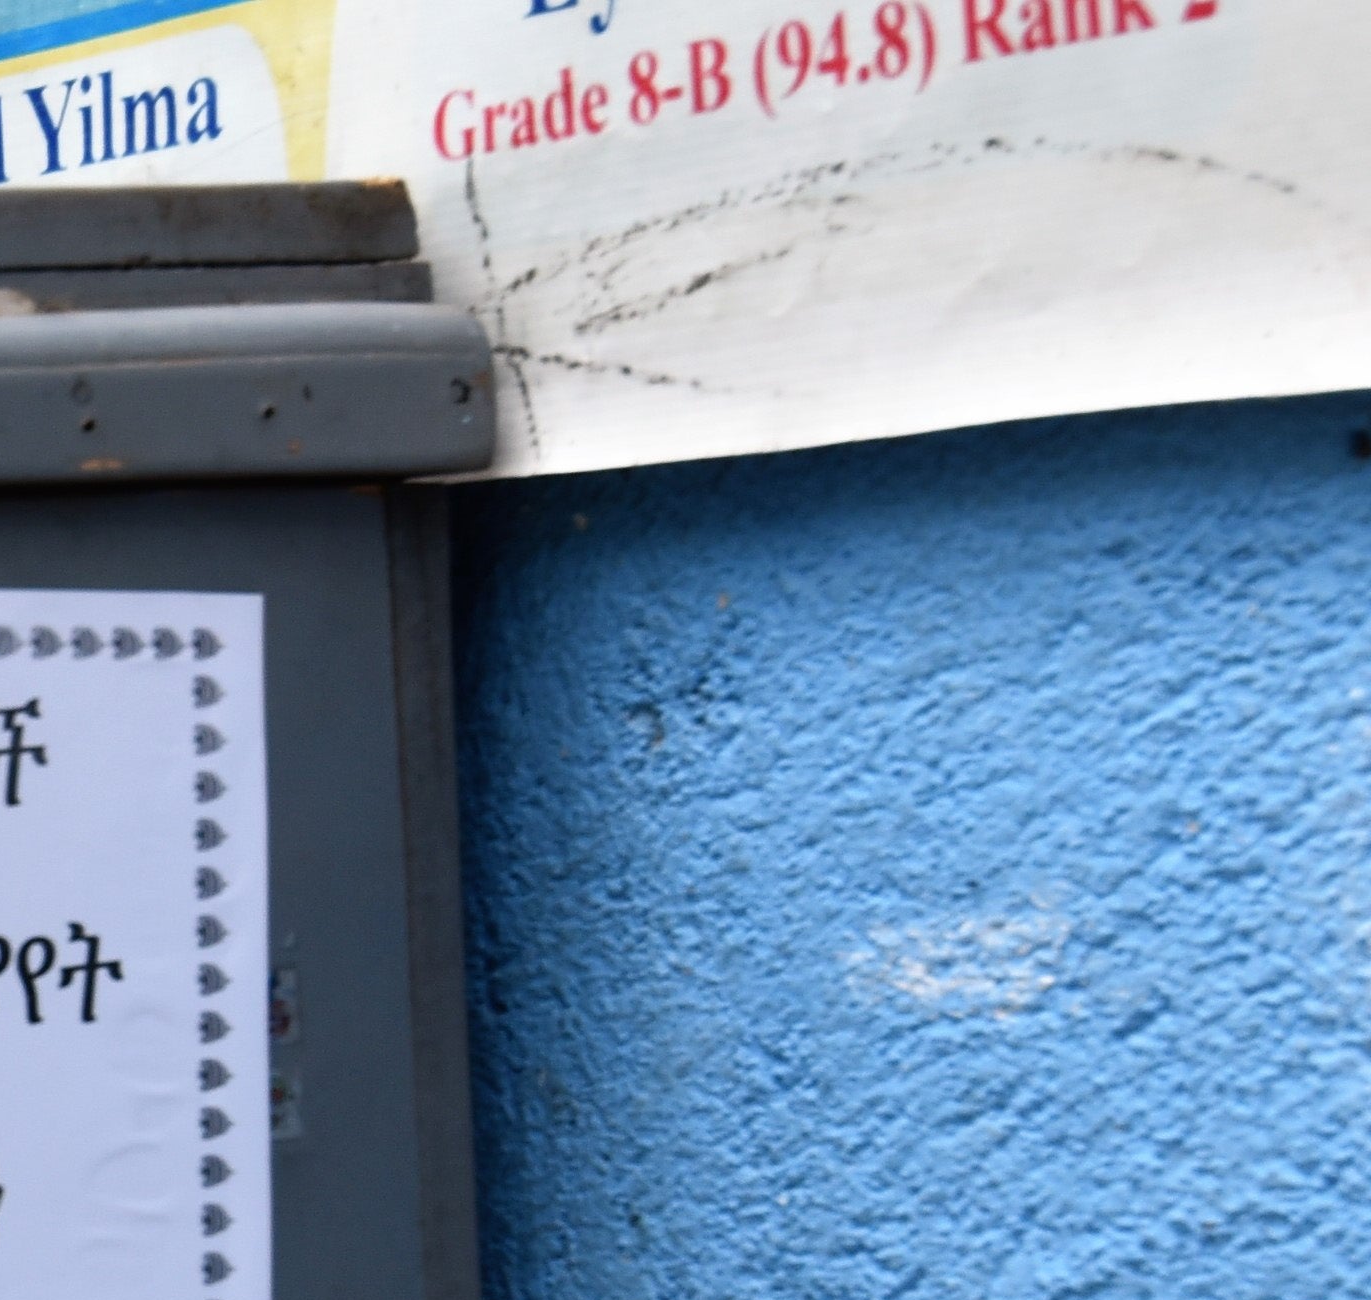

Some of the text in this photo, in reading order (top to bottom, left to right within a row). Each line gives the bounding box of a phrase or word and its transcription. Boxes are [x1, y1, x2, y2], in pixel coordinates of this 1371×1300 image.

[22, 71, 223, 176] Yilma
[432, 66, 612, 161] Grade
[627, 40, 733, 124] 8-B
[753, 0, 939, 117] (94.8)
